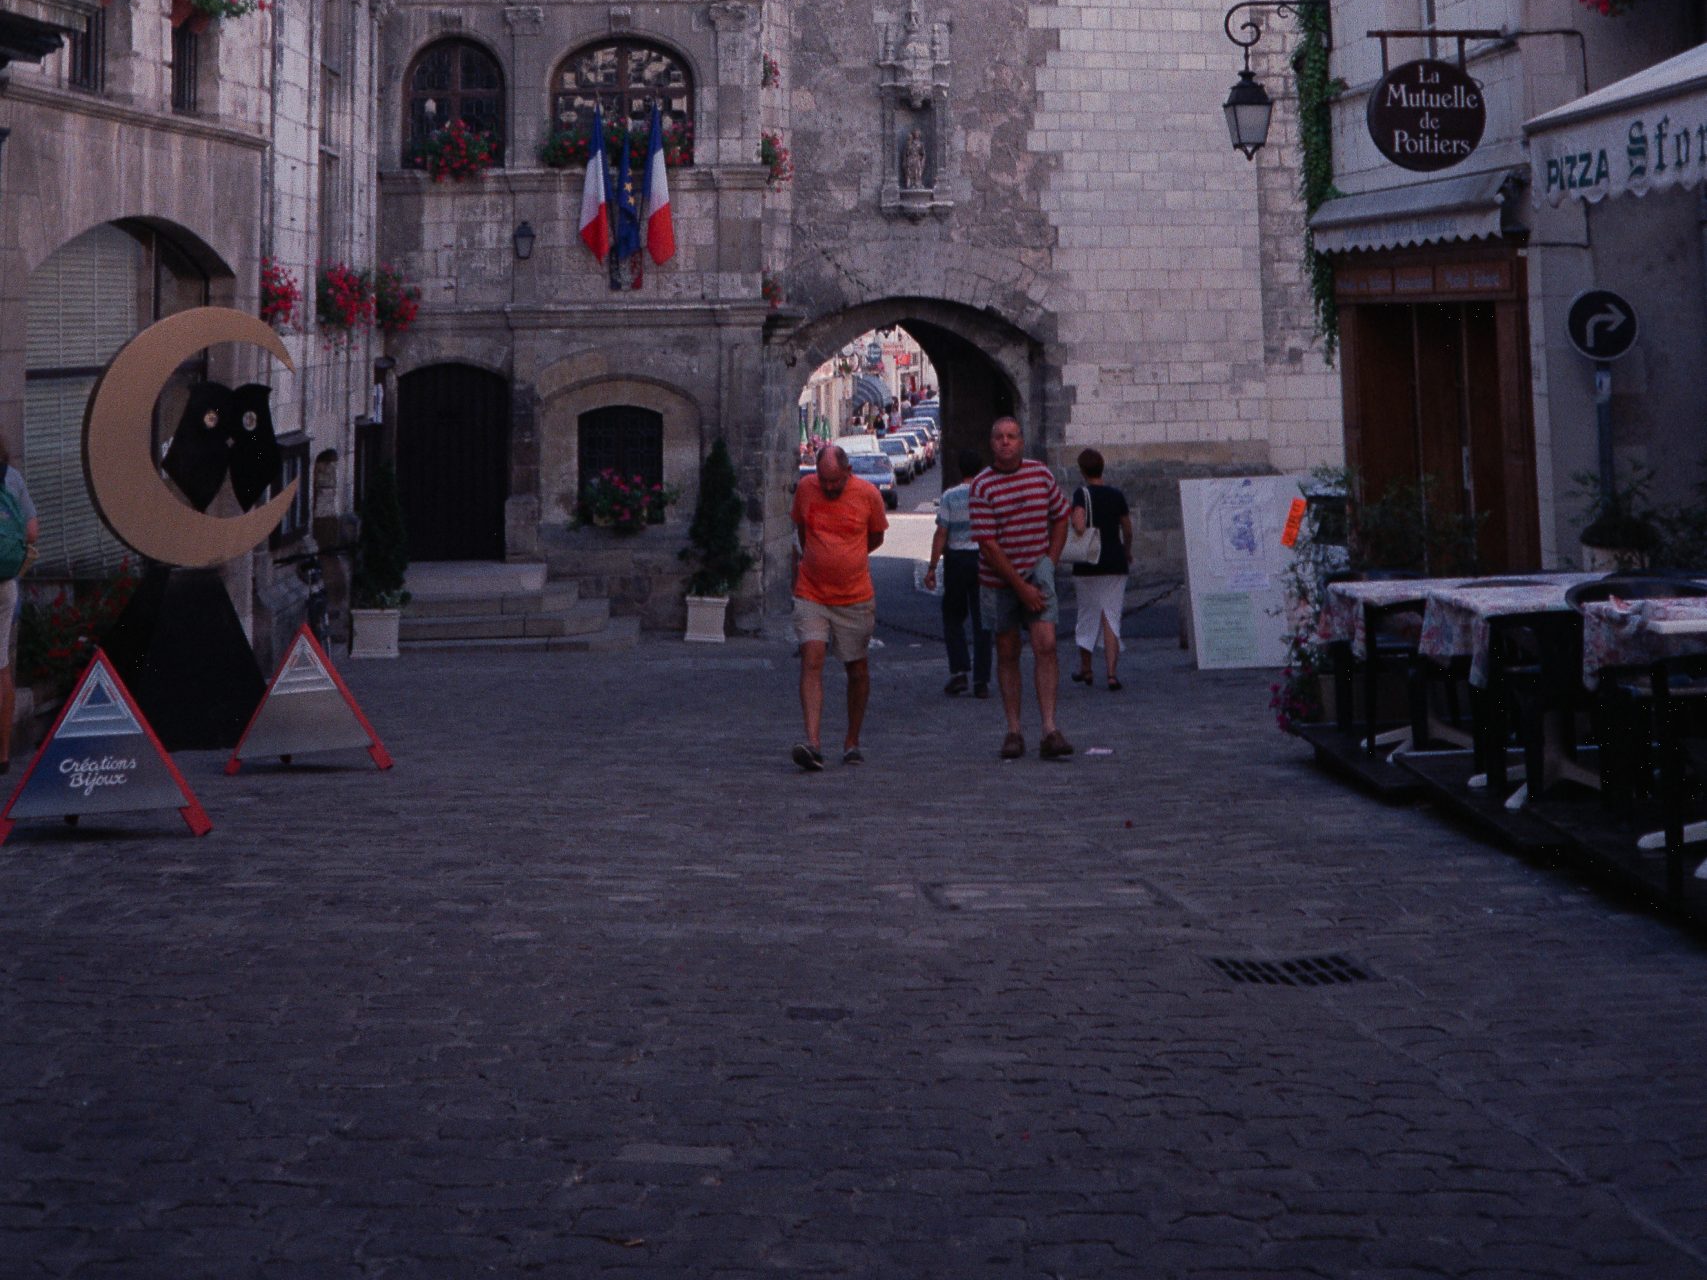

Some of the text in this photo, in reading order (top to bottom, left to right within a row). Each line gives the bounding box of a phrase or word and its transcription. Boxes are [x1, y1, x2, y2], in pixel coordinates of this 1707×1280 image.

[1419, 64, 1440, 84] La
[1386, 84, 1479, 109] Mutuelle
[1419, 111, 1440, 129] de
[1393, 129, 1471, 154] Poitiers
[1546, 148, 1611, 193] PIZZA
[59, 755, 137, 774] Créations
[69, 772, 128, 796] Bijoux
